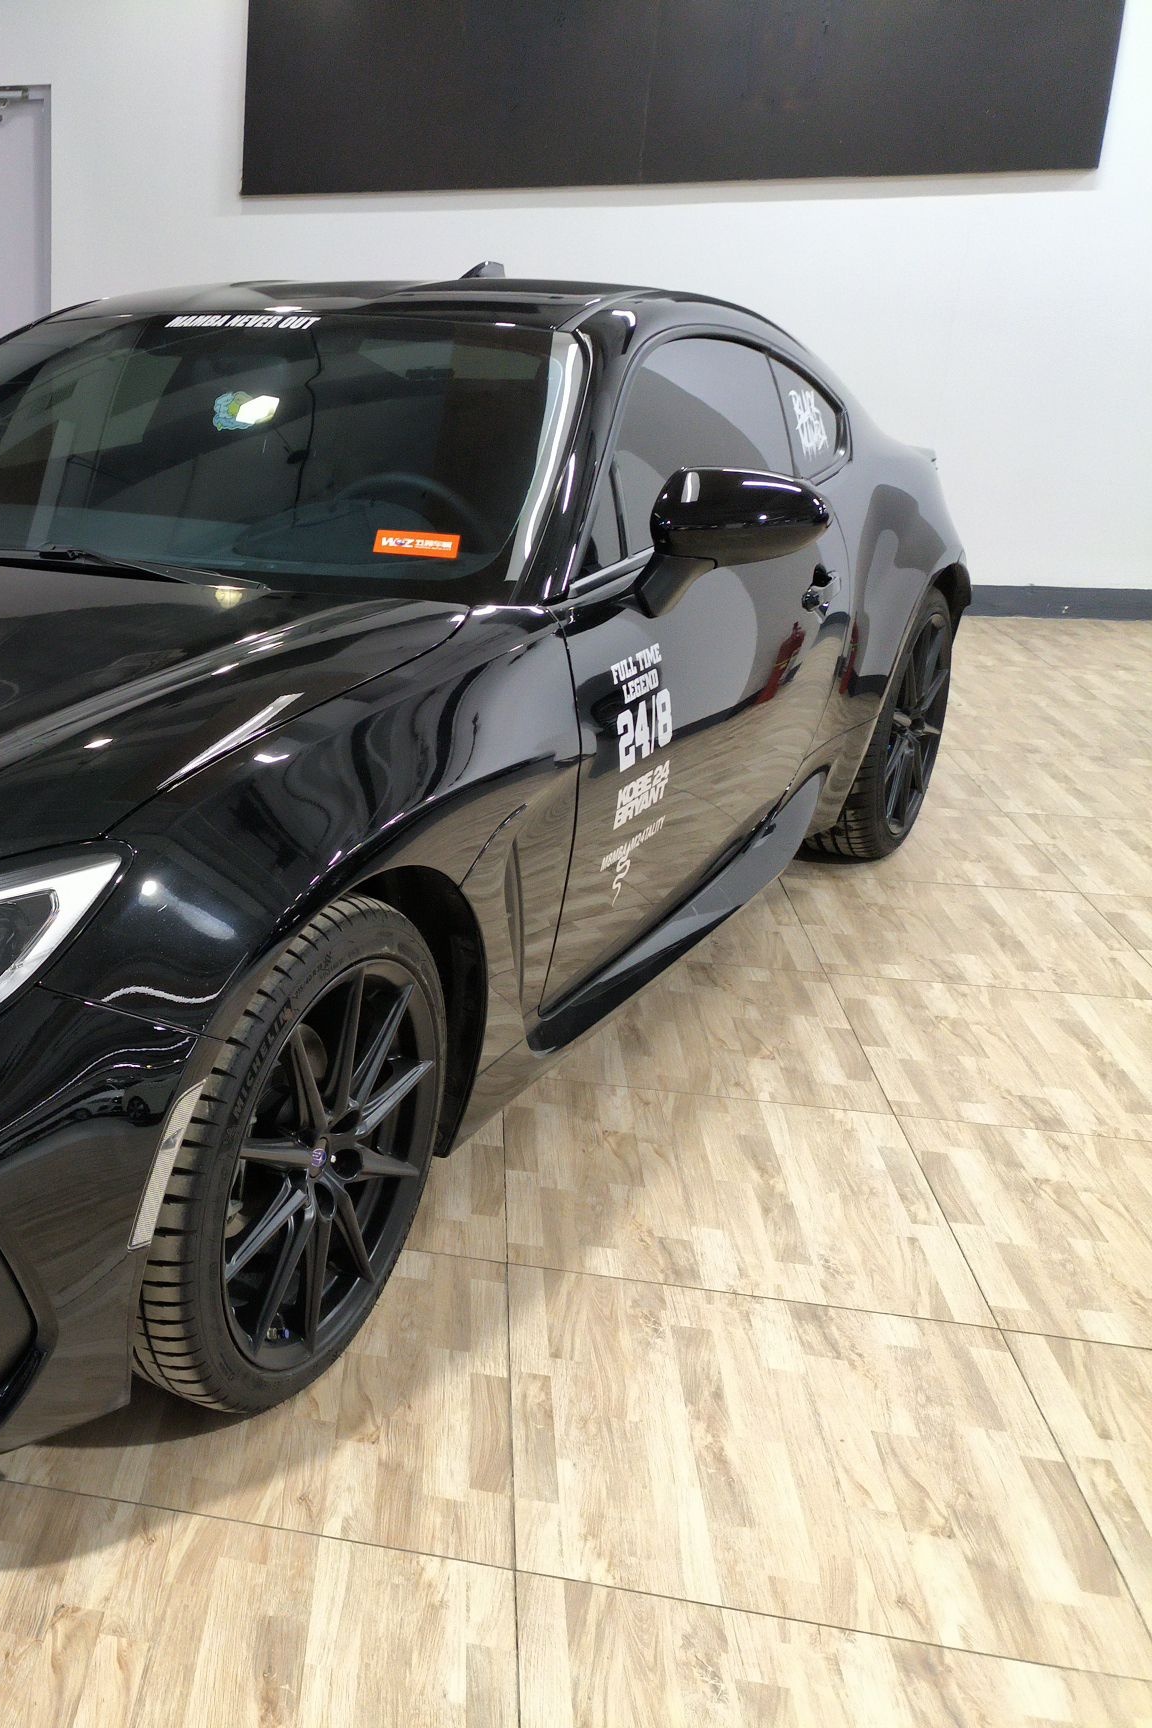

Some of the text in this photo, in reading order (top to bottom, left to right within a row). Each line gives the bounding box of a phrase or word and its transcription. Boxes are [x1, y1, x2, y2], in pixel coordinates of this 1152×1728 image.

[165, 315, 322, 330] MAMBA NEVER OUT
[610, 643, 662, 685] FULL TIME
[622, 668, 659, 704] LEGEND
[616, 688, 673, 773] 24/8
[613, 778, 669, 830] BRYANT
[616, 760, 670, 810] KOBE 24
